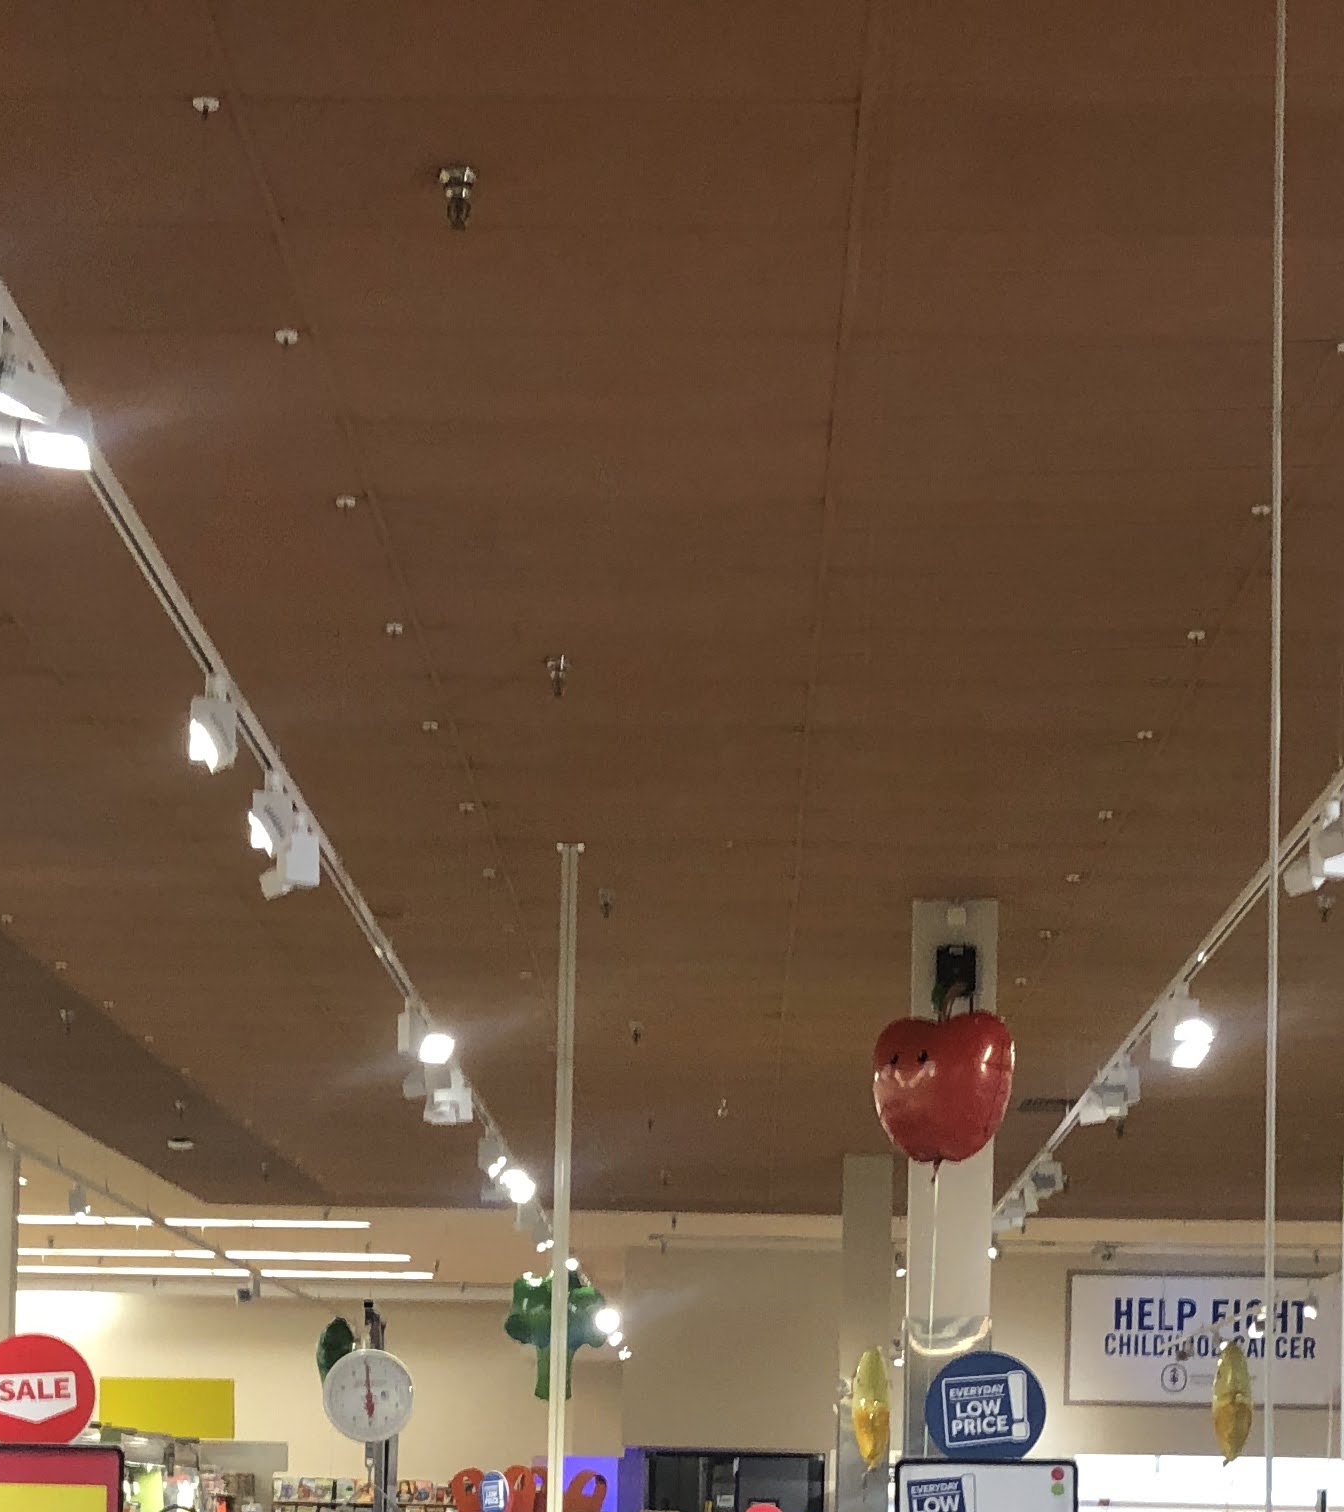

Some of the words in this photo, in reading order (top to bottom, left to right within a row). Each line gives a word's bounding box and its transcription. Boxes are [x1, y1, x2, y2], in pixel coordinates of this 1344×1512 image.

[1114, 1297, 1197, 1331] HELP
[948, 1383, 1005, 1399] EVERYDAY
[954, 1397, 1002, 1419] LOW
[951, 1415, 1010, 1438] PRICE
[910, 1480, 960, 1495] EVERYDAY
